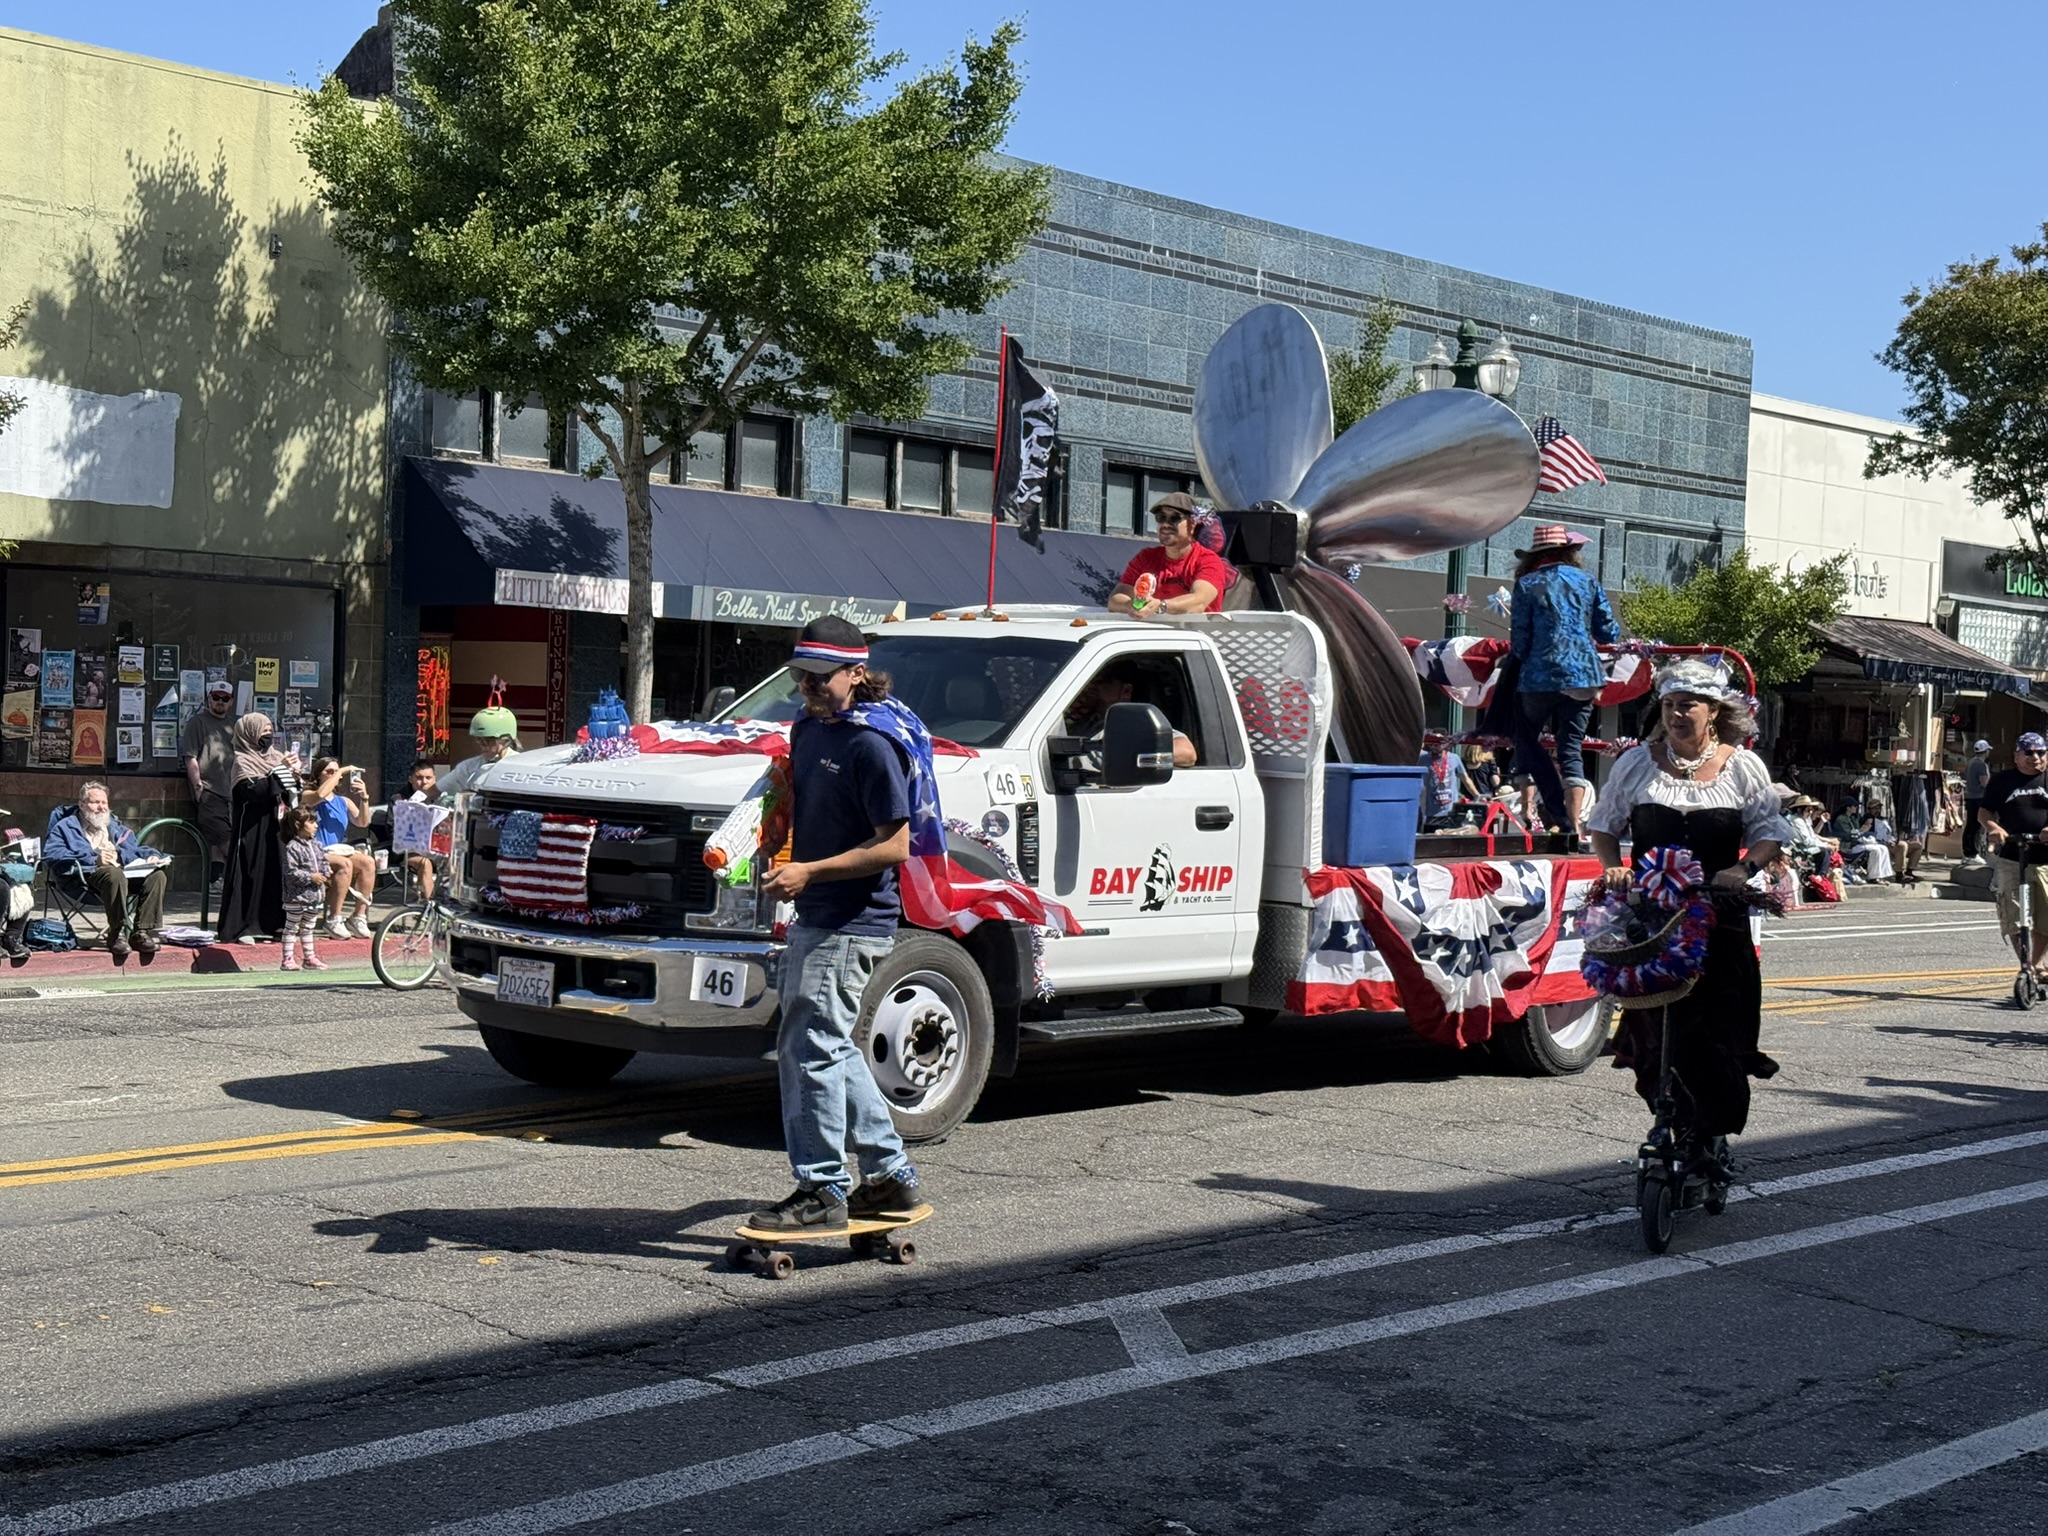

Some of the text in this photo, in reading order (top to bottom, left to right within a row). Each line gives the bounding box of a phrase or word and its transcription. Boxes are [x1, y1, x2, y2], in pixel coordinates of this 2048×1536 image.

[502, 576, 554, 605] LITTLE
[557, 580, 616, 611] PSYCHIC
[716, 591, 758, 618] Bella
[760, 595, 794, 621] Nail
[797, 600, 821, 626] Spa
[258, 661, 276, 669] IMP
[551, 609, 563, 742] RTUNE TELLE
[500, 772, 645, 793] SUPER DUTY
[996, 773, 1016, 796] 46
[1089, 866, 1233, 895] BAY SHIP
[503, 973, 550, 999] 70265E2
[704, 969, 734, 996] 46
